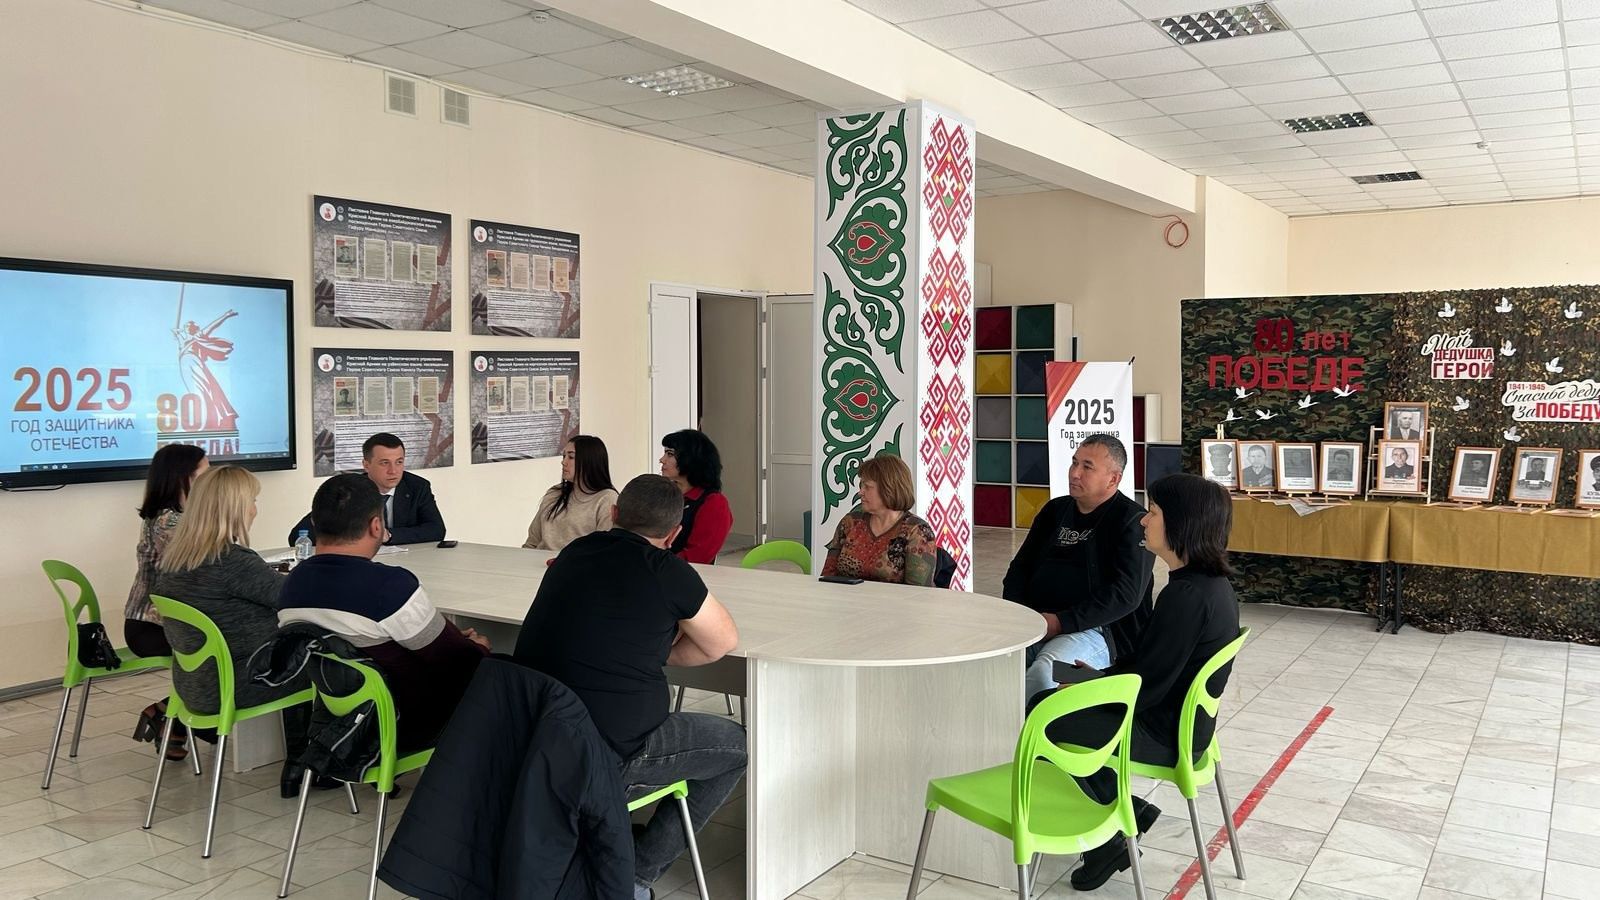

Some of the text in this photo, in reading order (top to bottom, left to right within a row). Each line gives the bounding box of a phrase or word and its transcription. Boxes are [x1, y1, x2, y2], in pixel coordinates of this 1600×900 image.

[1253, 318, 1352, 352] 80 лет
[1422, 328, 1473, 354] Мой
[1434, 349, 1493, 361] ДЕДУШКА
[1208, 354, 1365, 391] ПОБЕДЕ
[1433, 359, 1494, 378] ГЕРОЙ
[13, 367, 132, 412] 2025
[1504, 386, 1566, 404] Спасибо
[156, 393, 202, 432] 80
[1065, 398, 1115, 425] 2025
[11, 417, 135, 434] ГОД ЗАЩИТНИКА
[1060, 429, 1075, 440] Год
[31, 436, 119, 451] ОТЕЧЕСТВА
